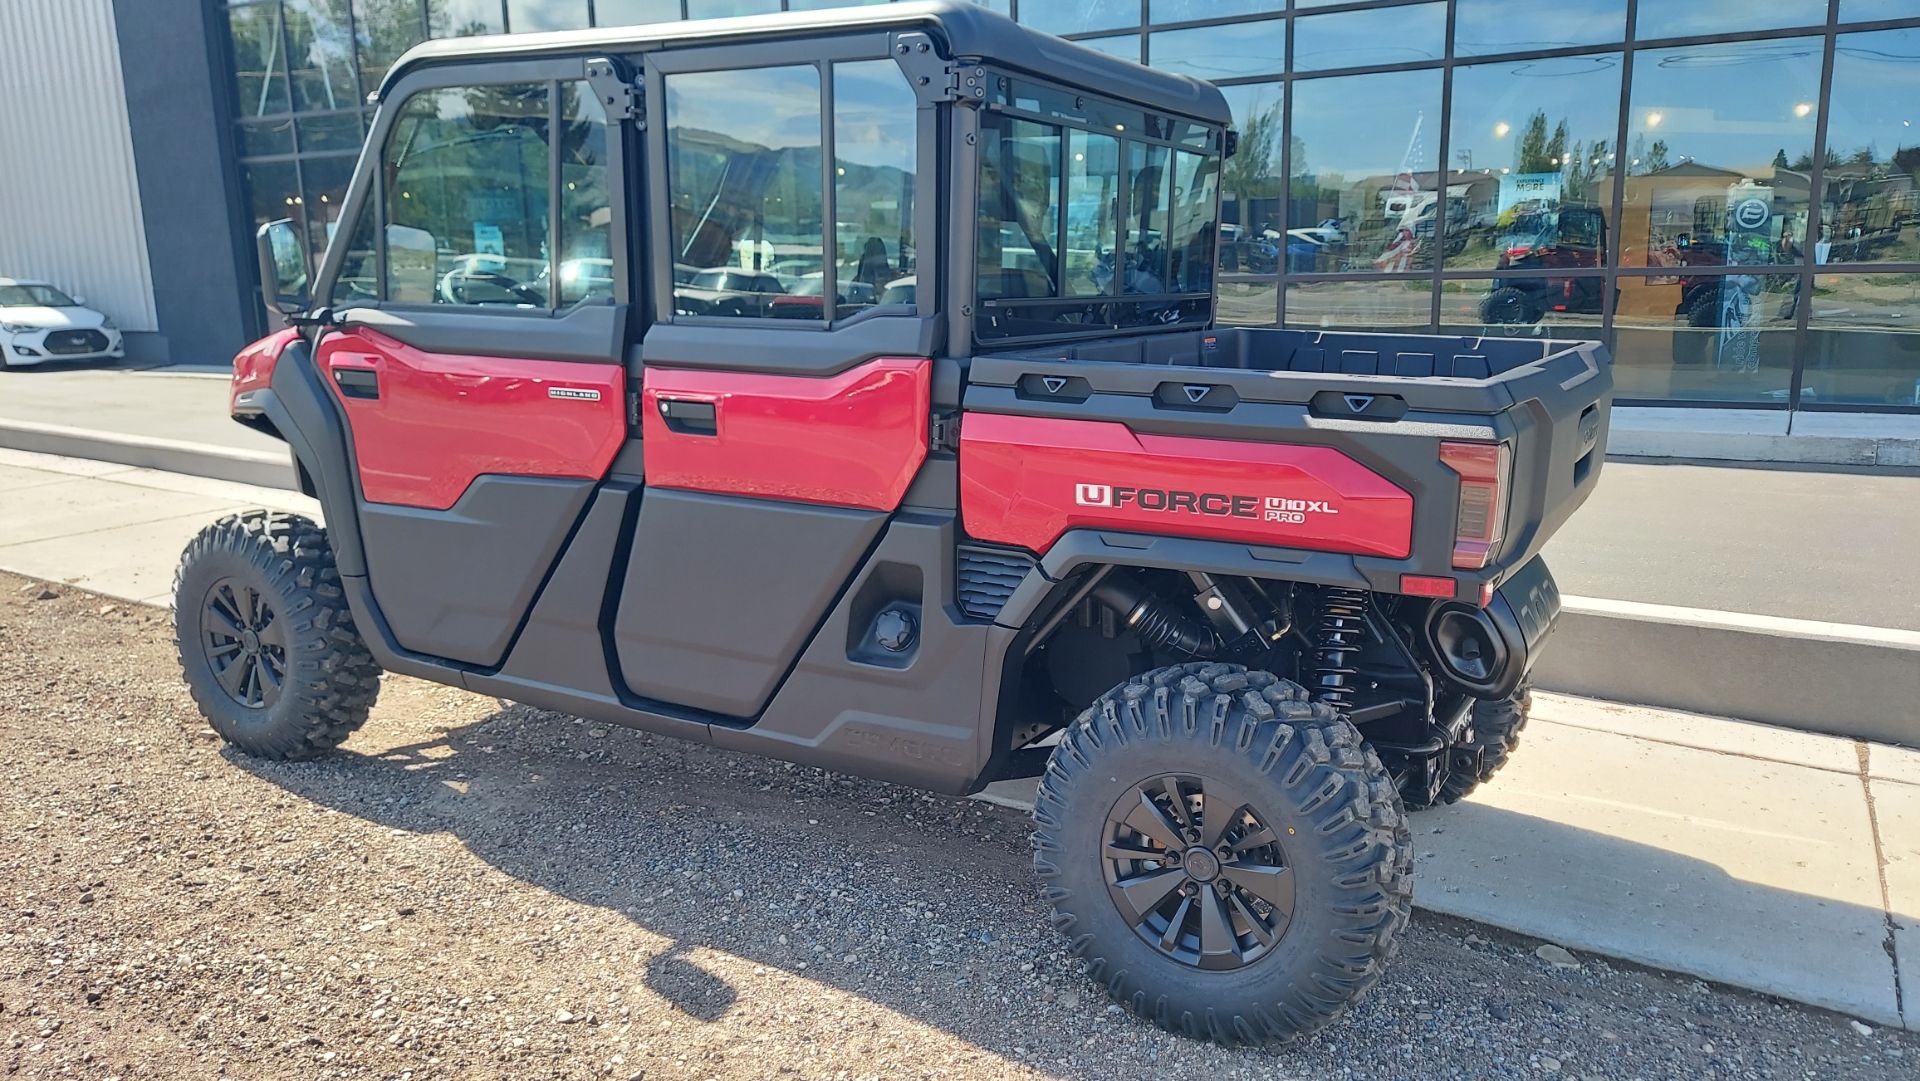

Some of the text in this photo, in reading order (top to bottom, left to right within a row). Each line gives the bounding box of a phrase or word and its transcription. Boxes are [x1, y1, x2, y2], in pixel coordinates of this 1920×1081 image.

[1515, 183, 1545, 192] MORE
[549, 389, 599, 399] HIGHLAND
[1264, 510, 1306, 525] PRO
